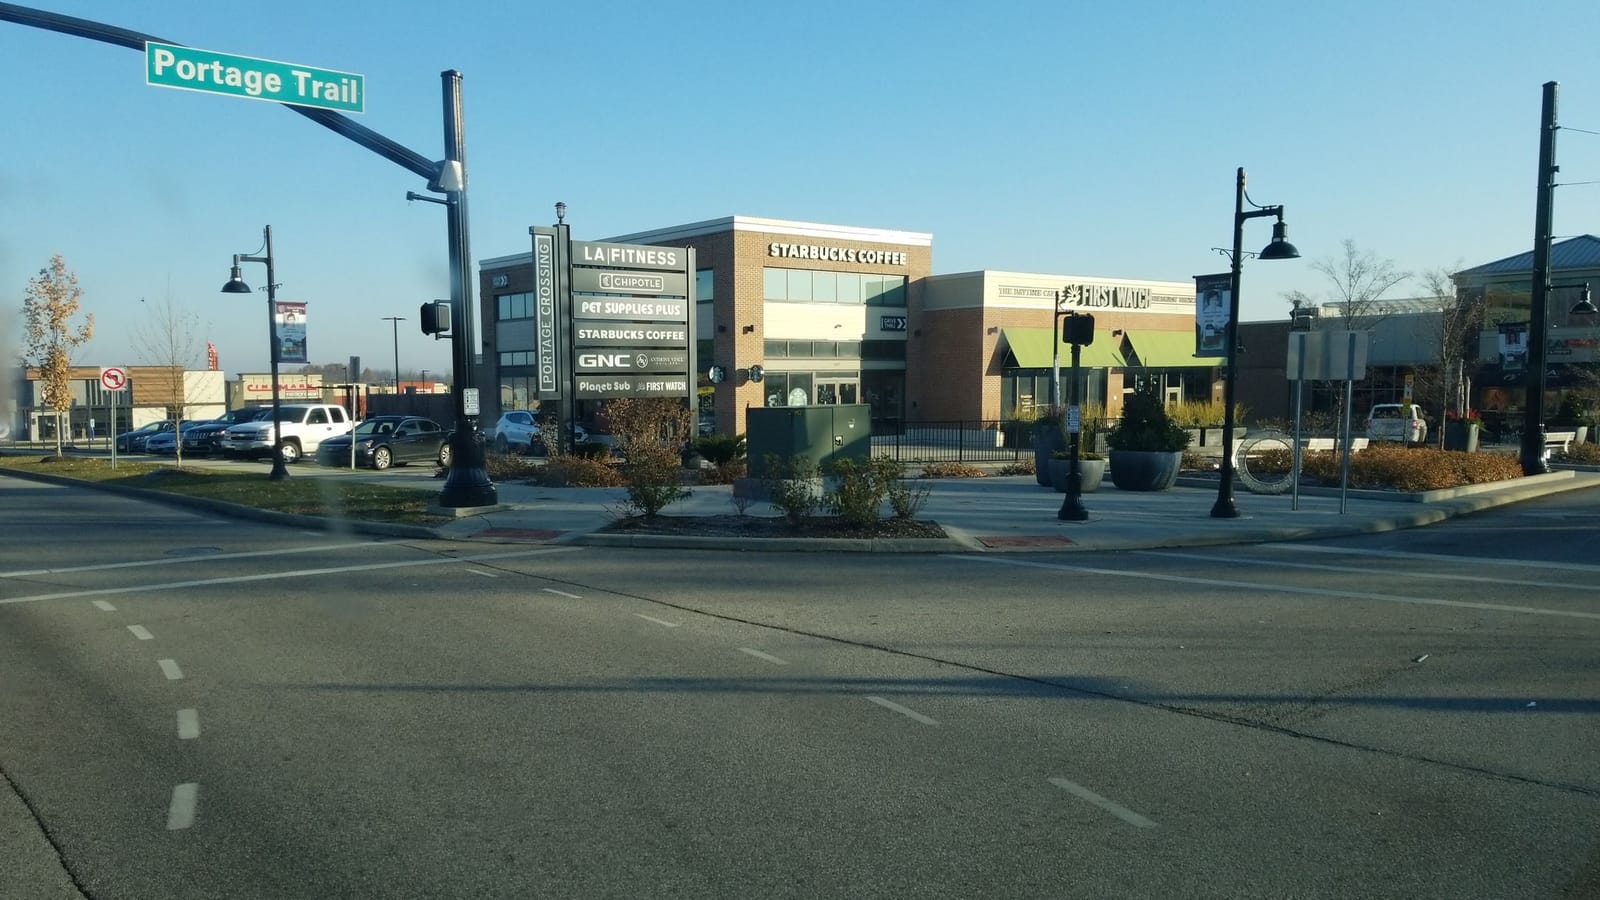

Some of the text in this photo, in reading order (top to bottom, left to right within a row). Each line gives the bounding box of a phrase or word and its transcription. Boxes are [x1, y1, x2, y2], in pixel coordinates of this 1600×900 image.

[154, 48, 357, 104] Portage Trail
[584, 246, 677, 266] LA FITNESS
[769, 242, 907, 266] STARBUCKS COFFEE
[614, 278, 661, 288] CHIPOTLE
[1080, 284, 1152, 309] FIRST WATCH
[539, 243, 553, 384] PORTAGE CROSSING
[581, 301, 681, 316] PET SUPPLIES PLUS
[578, 329, 685, 341] STARBUCKS COFFEE
[578, 354, 631, 368] GNC
[247, 384, 317, 392] CINMARK
[579, 381, 631, 393] Planet Sub
[646, 381, 687, 391] FIRST WATCH
